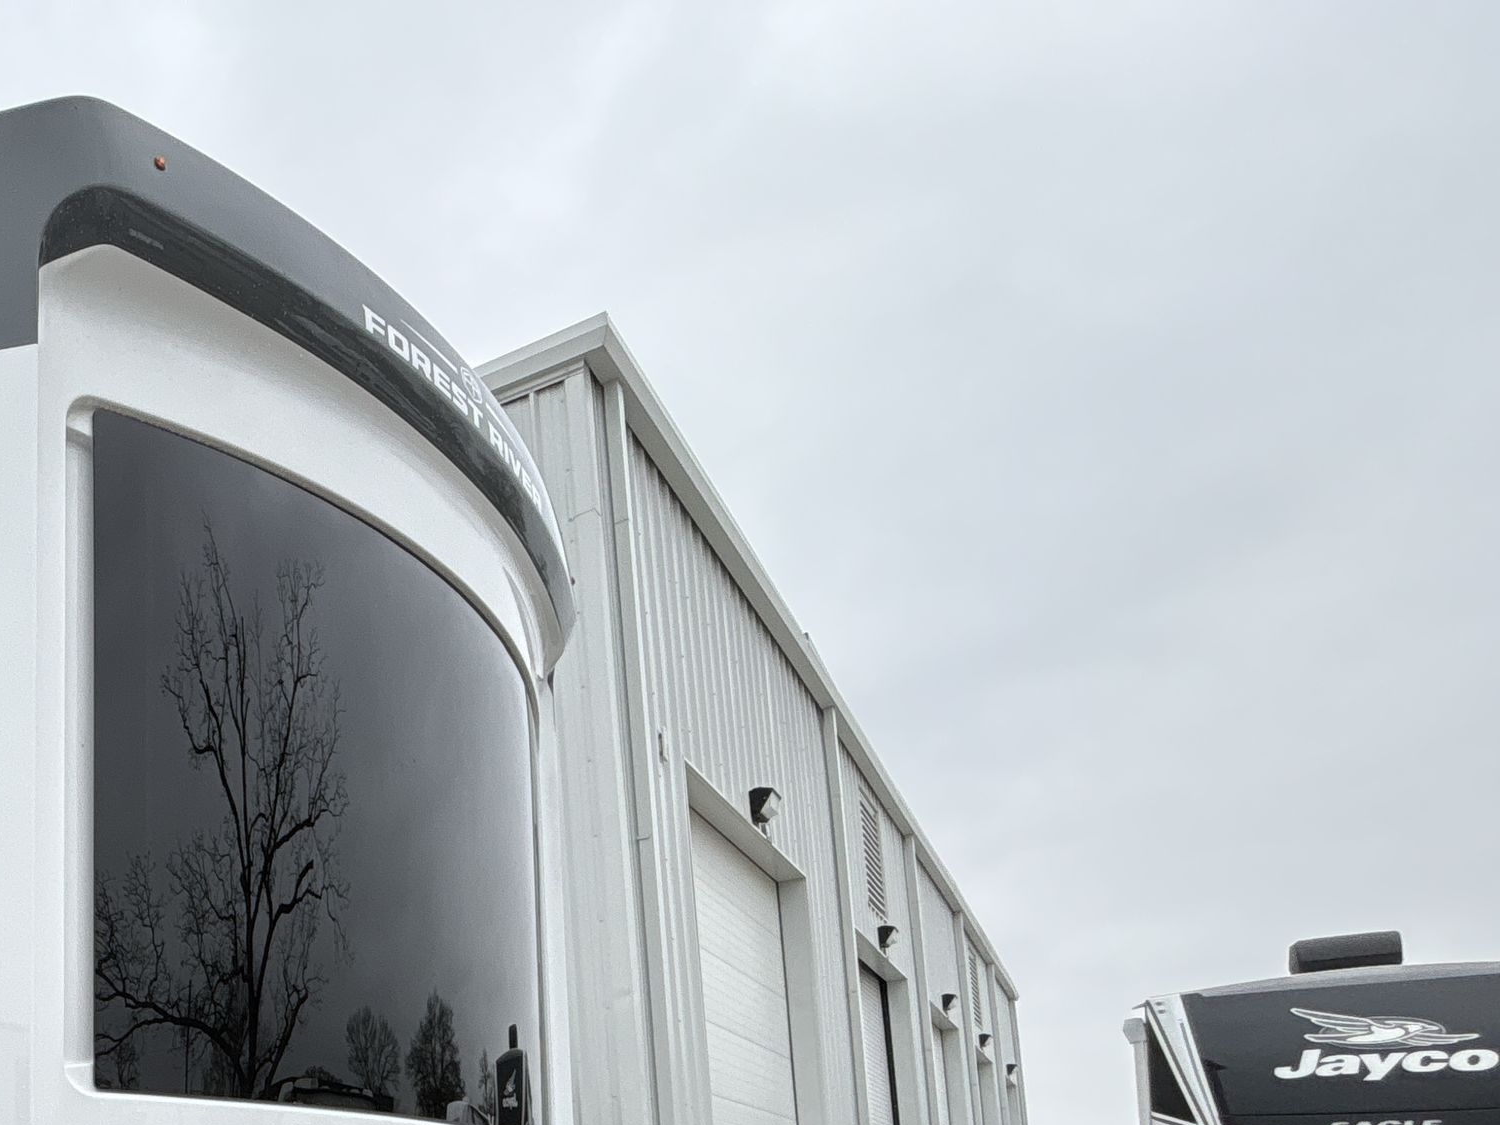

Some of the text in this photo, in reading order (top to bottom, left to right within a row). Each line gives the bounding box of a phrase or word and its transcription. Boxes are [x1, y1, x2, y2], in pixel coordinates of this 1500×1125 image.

[362, 304, 542, 515] FOREST RIVER
[1274, 1049, 1499, 1081] Jayco
